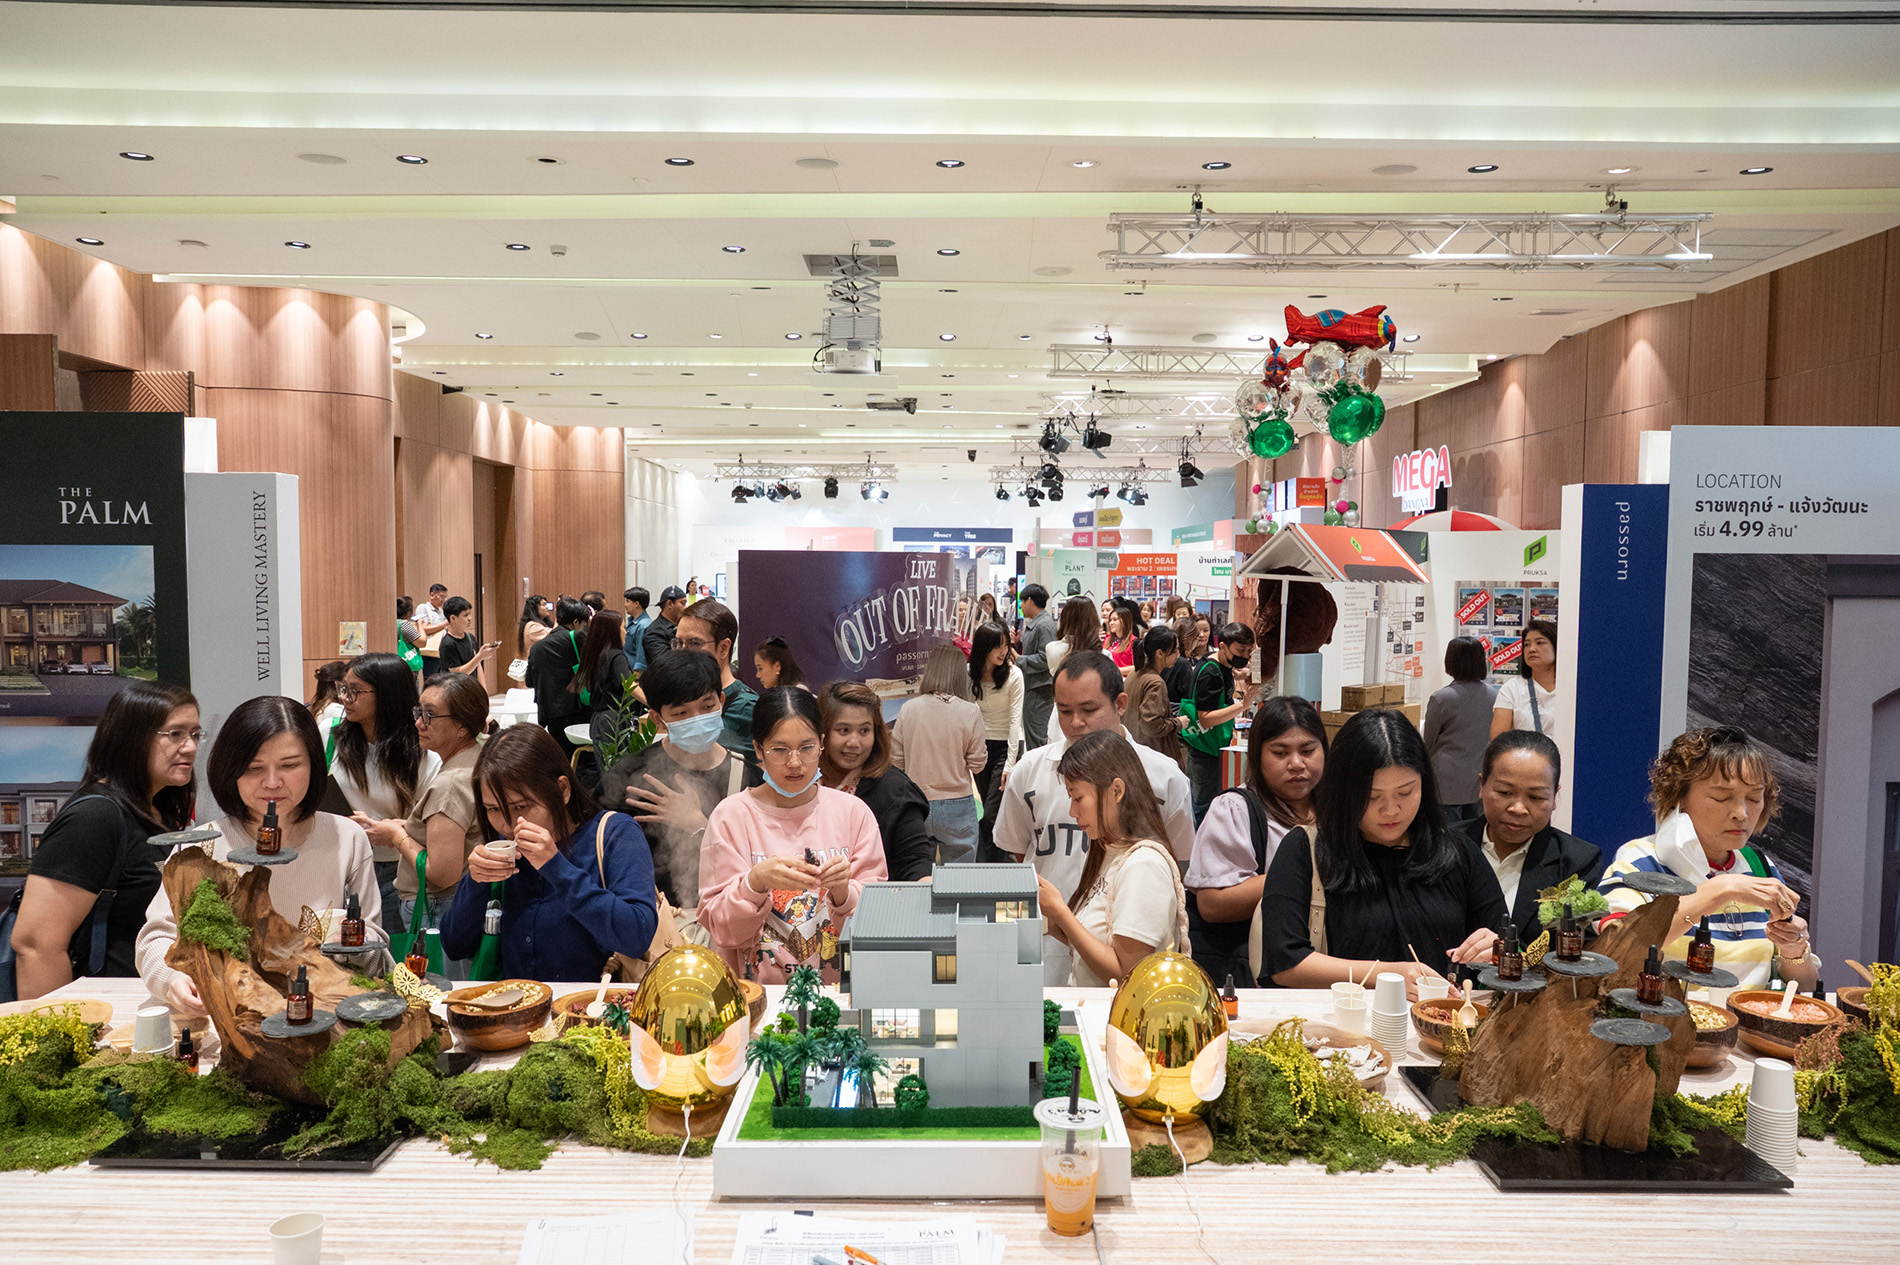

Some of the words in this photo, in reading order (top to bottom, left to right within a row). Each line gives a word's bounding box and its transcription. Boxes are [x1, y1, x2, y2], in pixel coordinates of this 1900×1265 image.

[1394, 446, 1450, 507] MEGA
[1696, 474, 1782, 489] LOCATION
[58, 488, 92, 497] THE
[58, 500, 152, 525] PALM
[1695, 496, 1773, 516] ราชพฤกษ์
[1790, 496, 1869, 514] แจ้งวัฒนะ
[252, 490, 267, 569] MASTERY
[1615, 502, 1630, 580] passorn
[1694, 520, 1715, 537] เริ่ม
[1720, 520, 1764, 537] 4.99
[910, 560, 936, 580] LIVE
[256, 573, 269, 631] LIVING
[1460, 604, 1476, 618] SOLD
[1476, 593, 1487, 606] OUT
[840, 596, 888, 664] OUT
[892, 586, 920, 635] OF
[258, 636, 270, 681] WELL
[1493, 651, 1511, 664] SOLD
[919, 1229, 954, 1238] PALM
